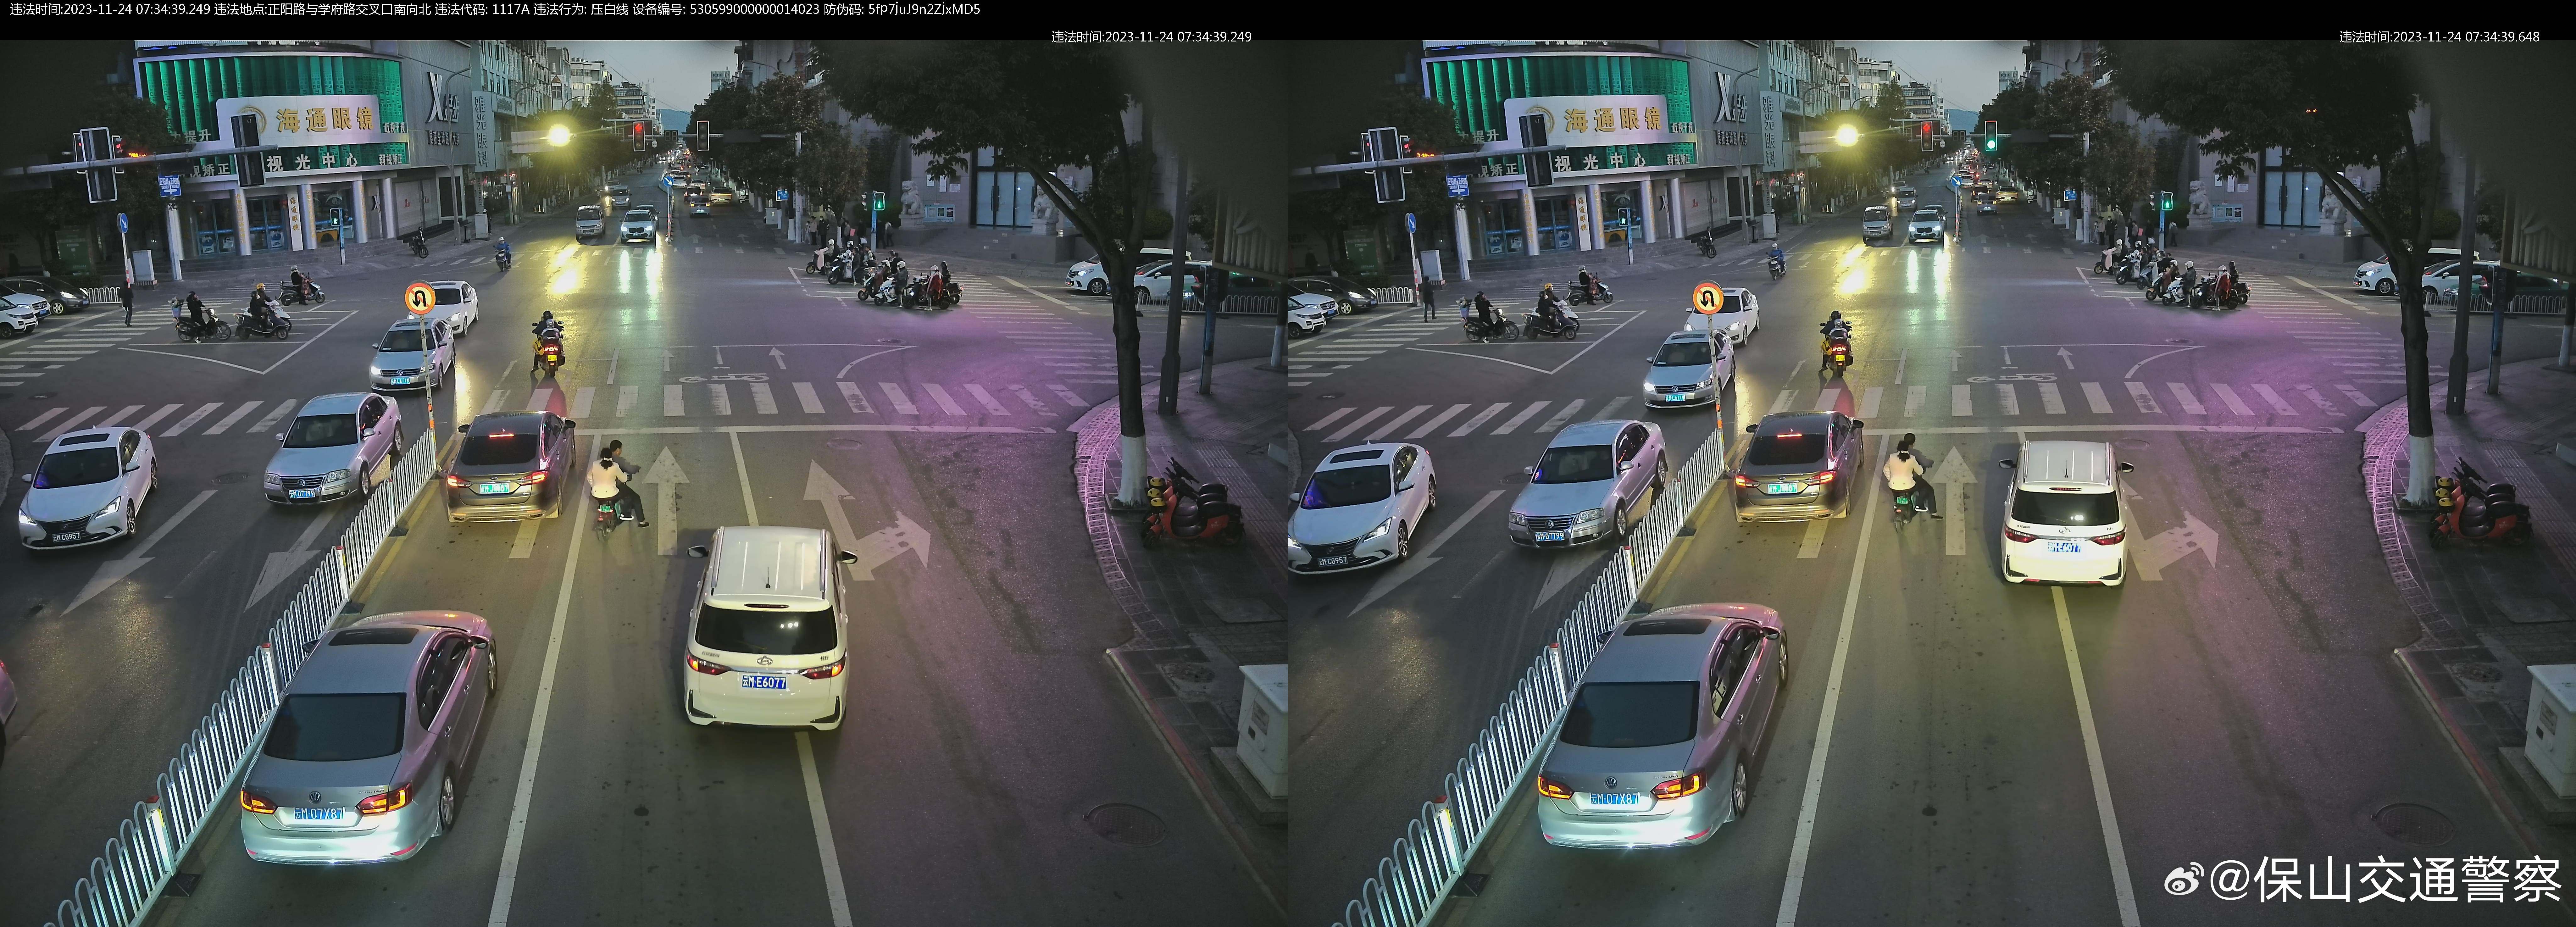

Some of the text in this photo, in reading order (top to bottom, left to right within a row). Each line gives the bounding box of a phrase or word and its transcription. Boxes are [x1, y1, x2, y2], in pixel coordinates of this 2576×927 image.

[277, 107, 374, 132] 海通眼镜
[1565, 107, 1662, 132] 海通眼镜
[429, 130, 460, 145] 屡获全球跑大奖
[475, 96, 489, 167] 雅光眼科
[1717, 130, 1748, 145] 屡获全球跑大奖
[1763, 96, 1777, 167] 雅光眼科
[267, 152, 358, 172] 视光中心
[379, 154, 402, 165] 弱视矫正
[1555, 152, 1646, 172] 视光中心
[1667, 154, 1690, 165] 弱视矫正
[290, 197, 299, 230] 海通眼镜
[1578, 197, 1587, 230] 海通眼镜
